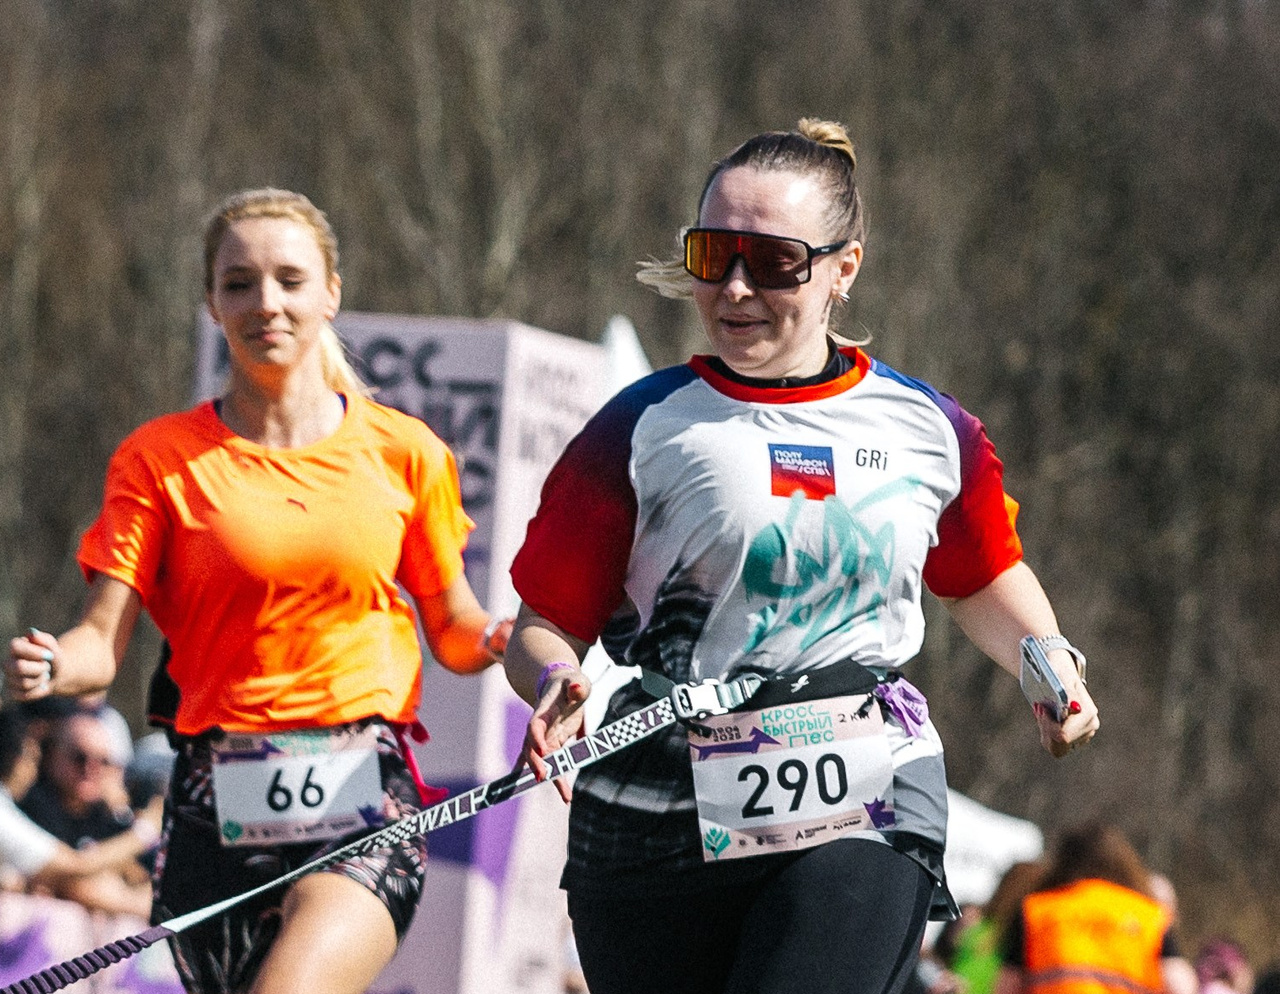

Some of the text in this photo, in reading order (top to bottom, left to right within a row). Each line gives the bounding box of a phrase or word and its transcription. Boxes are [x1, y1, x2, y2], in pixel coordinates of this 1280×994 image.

[855, 448, 888, 471] GRi
[837, 712, 847, 723] 2
[266, 766, 325, 811] 66
[417, 729, 613, 834] WALK RUN
[737, 753, 849, 819] 290
